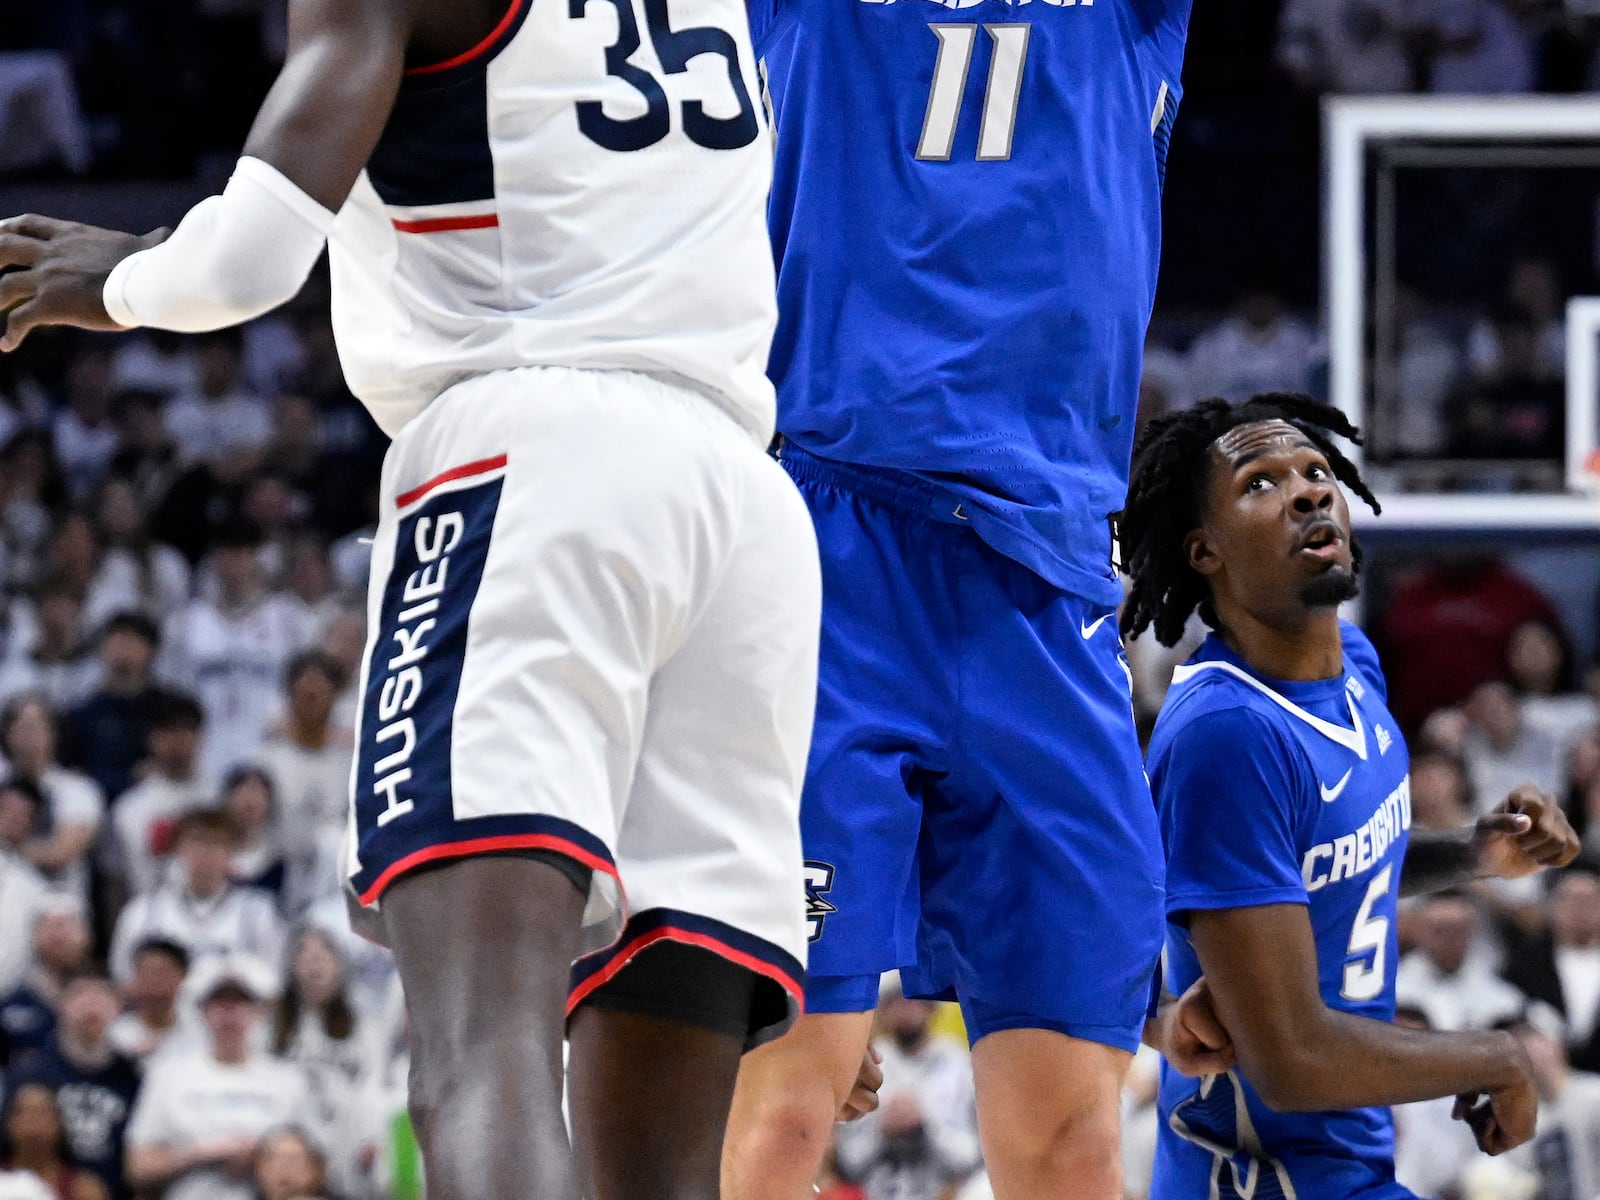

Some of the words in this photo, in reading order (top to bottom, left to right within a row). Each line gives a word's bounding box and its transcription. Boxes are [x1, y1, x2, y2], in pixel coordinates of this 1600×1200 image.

[914, 22, 1031, 161] 11
[373, 511, 465, 827] HUSKIES
[1338, 861, 1392, 1001] 5
